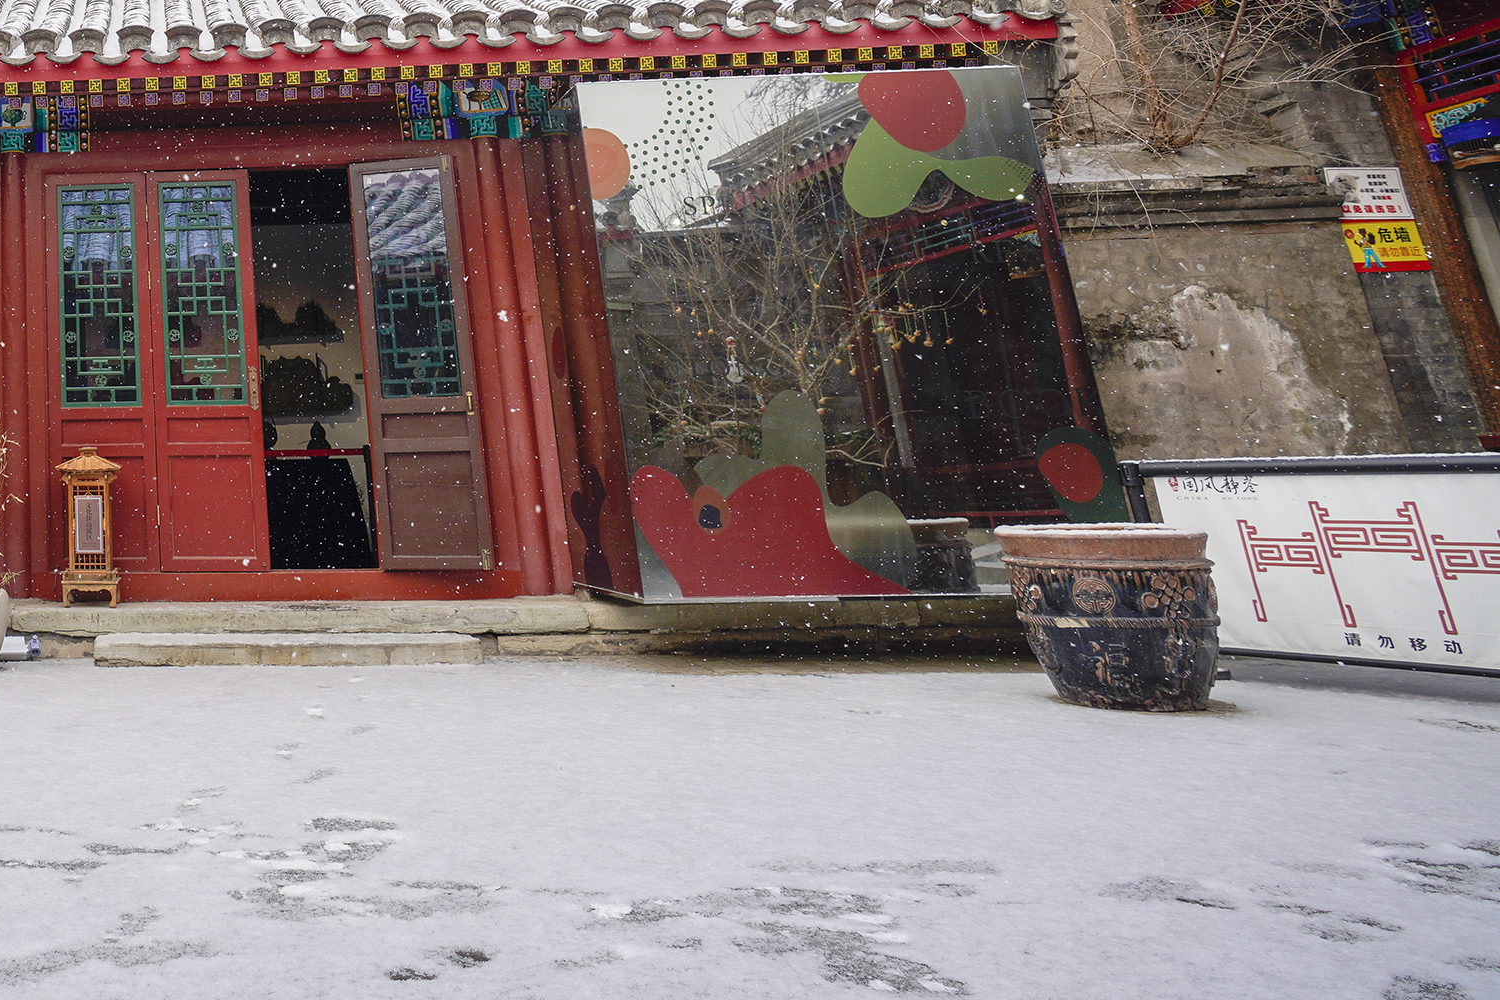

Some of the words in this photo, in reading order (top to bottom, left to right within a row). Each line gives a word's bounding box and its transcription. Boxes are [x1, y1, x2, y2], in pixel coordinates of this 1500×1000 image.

[1377, 227, 1412, 243] 危墙
[1378, 246, 1422, 258] 请勿靠近
[1344, 632, 1463, 655] 请勿移动
